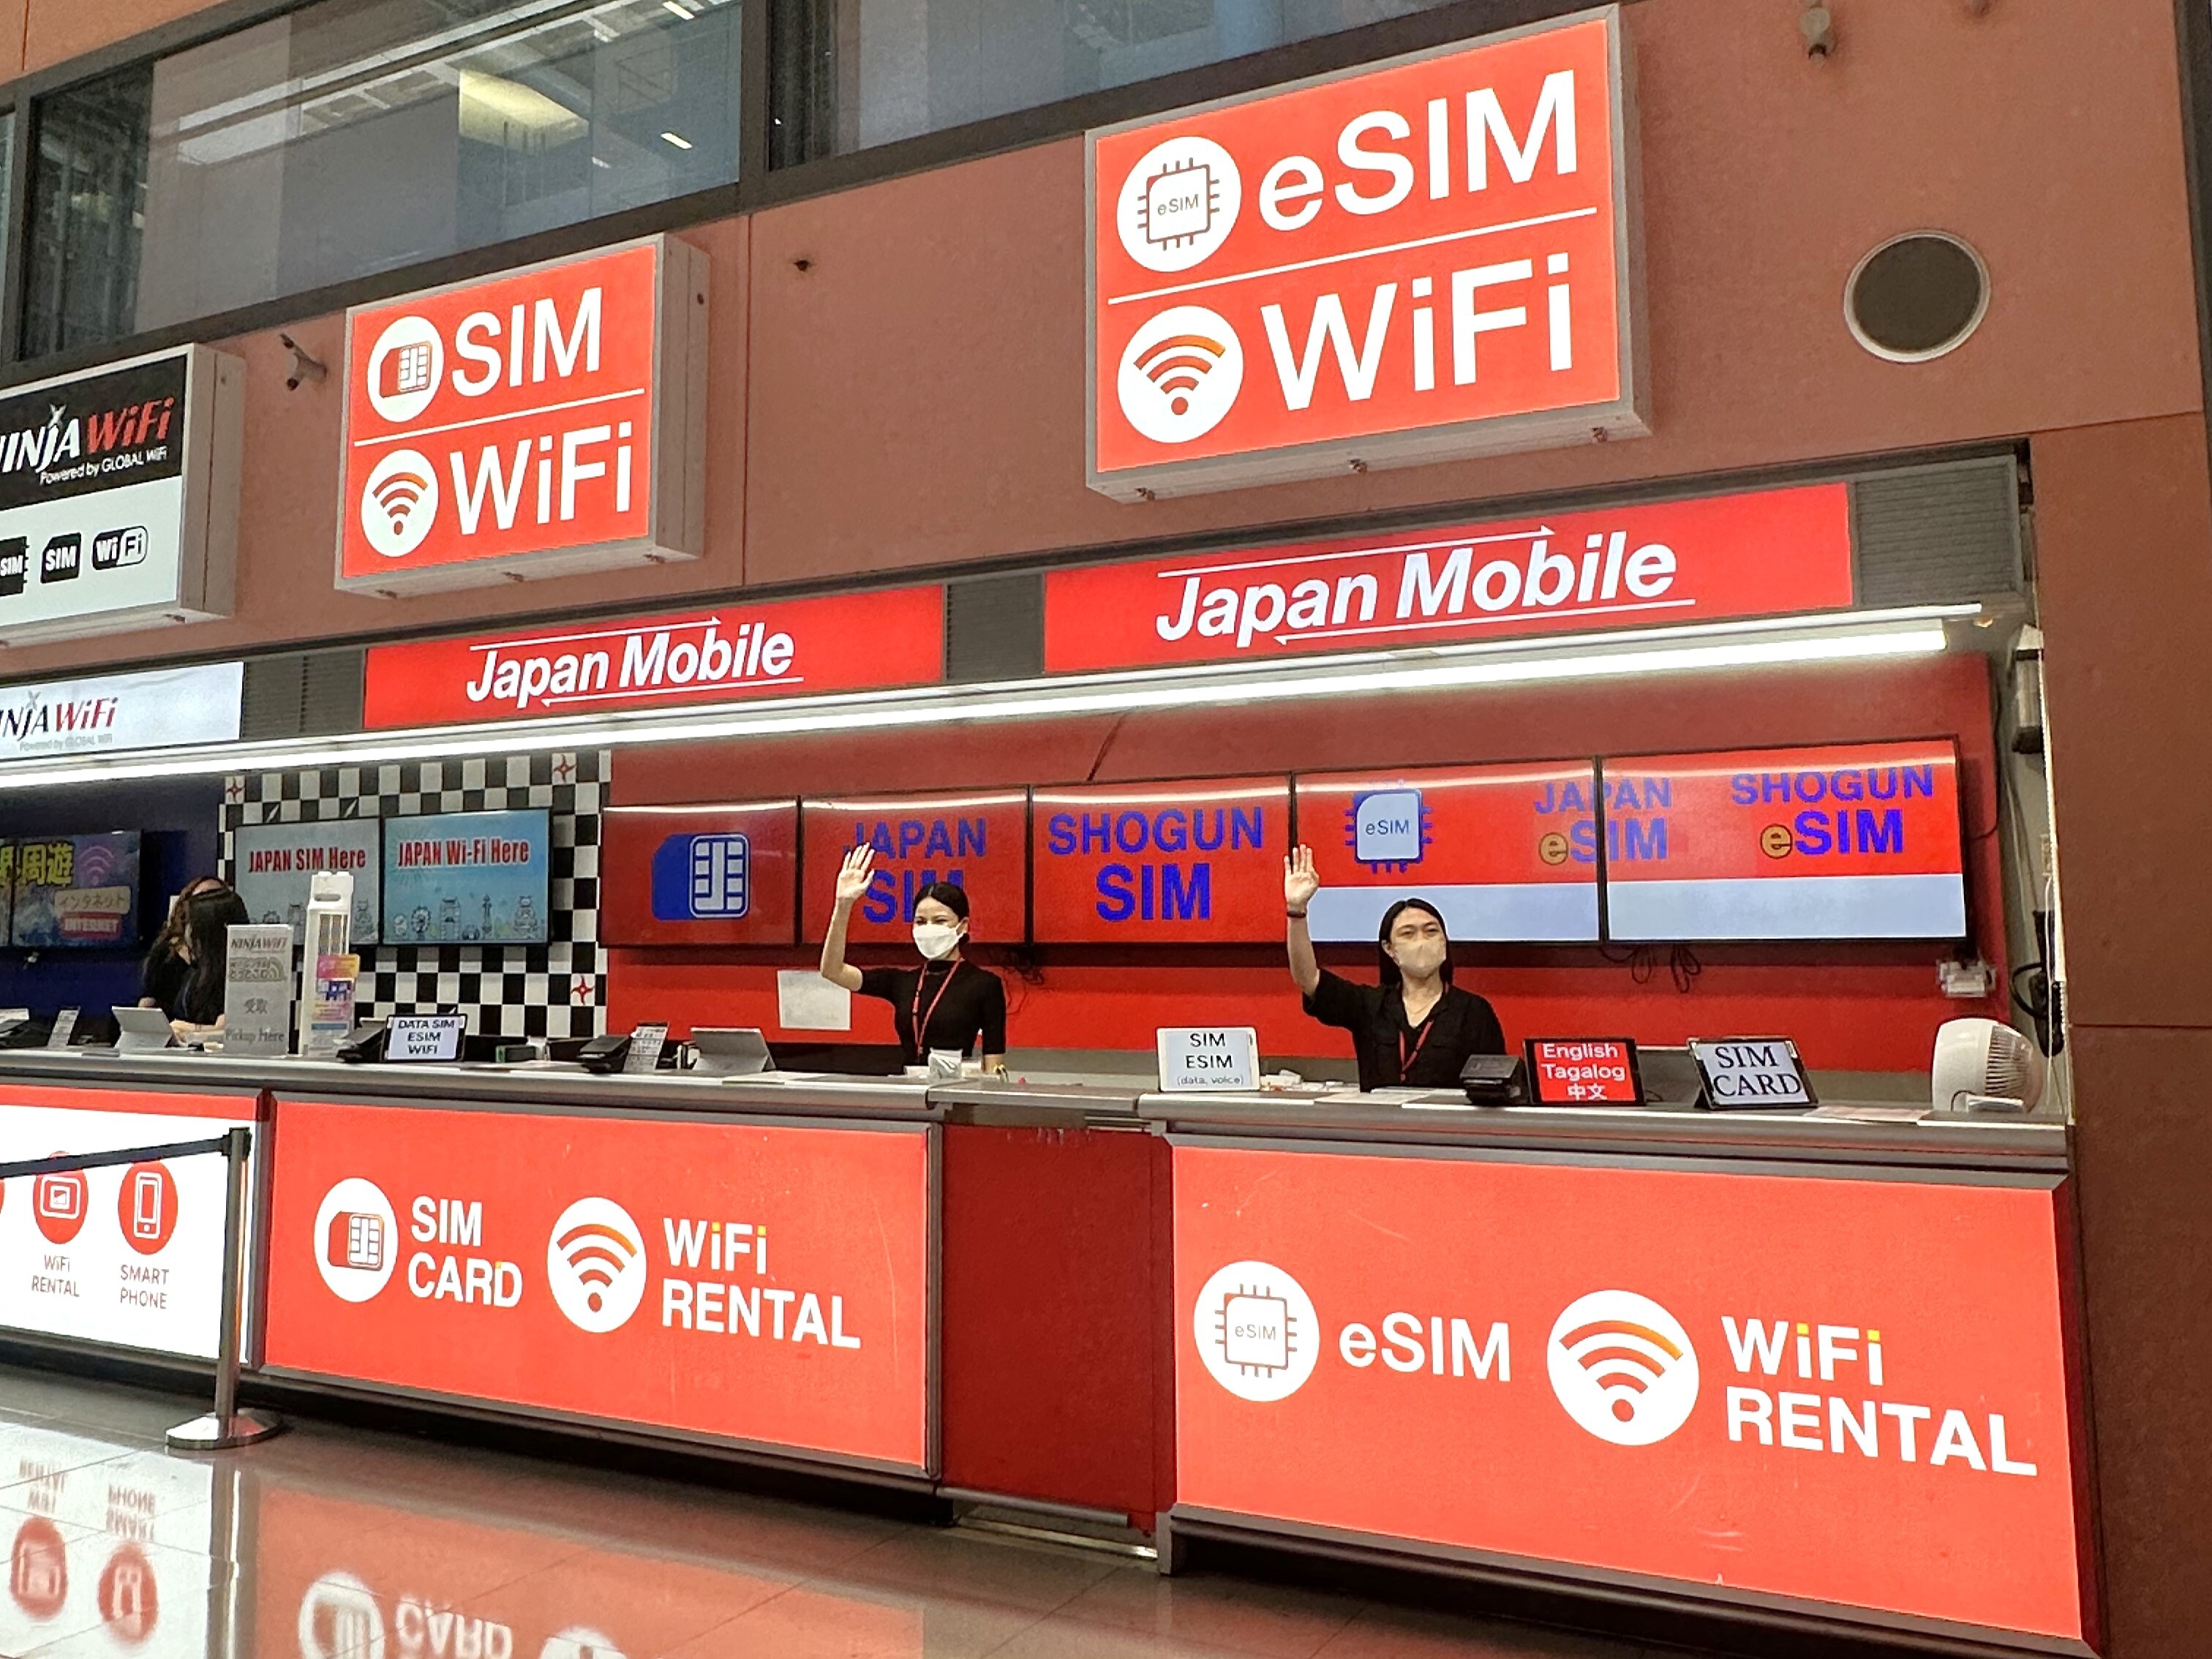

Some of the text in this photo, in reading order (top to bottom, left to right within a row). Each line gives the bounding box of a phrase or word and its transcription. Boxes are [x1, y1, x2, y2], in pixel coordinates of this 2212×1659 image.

[1259, 69, 1577, 231] eSIM
[1157, 194, 1199, 215] eSIM
[452, 287, 602, 396] SIM
[1260, 252, 1572, 411] WiFi
[86, 396, 174, 454] WiFi
[40, 463, 85, 486] Powered
[86, 462, 99, 477] by
[101, 451, 145, 473] GLOBAL
[449, 421, 632, 535] WiFi
[45, 546, 77, 571] SIM
[96, 533, 143, 562] WiFi
[1156, 531, 1676, 648] Japan Mobile
[467, 622, 795, 709] Japan Mobile
[56, 697, 118, 732] WiFi
[1534, 777, 1672, 815] JAPAN
[1731, 764, 1934, 805] SHOGUN
[1048, 807, 1263, 855] SHOGUN
[1365, 819, 1410, 838] eSIM
[1539, 817, 1668, 865] eSIM
[1761, 808, 1903, 859] eSIM
[249, 846, 366, 873] JAPAN SIM Here
[397, 838, 530, 868] JAPAN Wi-Fi Here
[1096, 862, 1212, 922] SIM
[259, 1026, 286, 1042] Here
[398, 1019, 455, 1029] DATA SIM
[407, 1031, 441, 1042] ESIM
[1189, 1033, 1226, 1047] SIM
[407, 1045, 438, 1055] WIFI
[1185, 1055, 1233, 1069] ESIM
[1543, 1043, 1618, 1061] English
[1715, 1045, 1780, 1069] SIM
[1541, 1064, 1625, 1082] Tagalog
[1712, 1073, 1802, 1097] CARD
[1567, 1083, 1608, 1101] 中文
[412, 1197, 483, 1246] SIM
[663, 1218, 767, 1274] WiFi
[44, 1254, 71, 1273] WiFi
[120, 1264, 170, 1285] SMART
[31, 1275, 80, 1298] RENTAL
[408, 1252, 522, 1309] CARD
[119, 1287, 168, 1309] PHONE
[662, 1278, 862, 1350] RENTAL
[1234, 1323, 1276, 1341] eSIM
[1339, 1311, 1511, 1382] eSIM
[1720, 1316, 1884, 1385] WiFi
[1726, 1385, 2038, 1477] RENTAL
